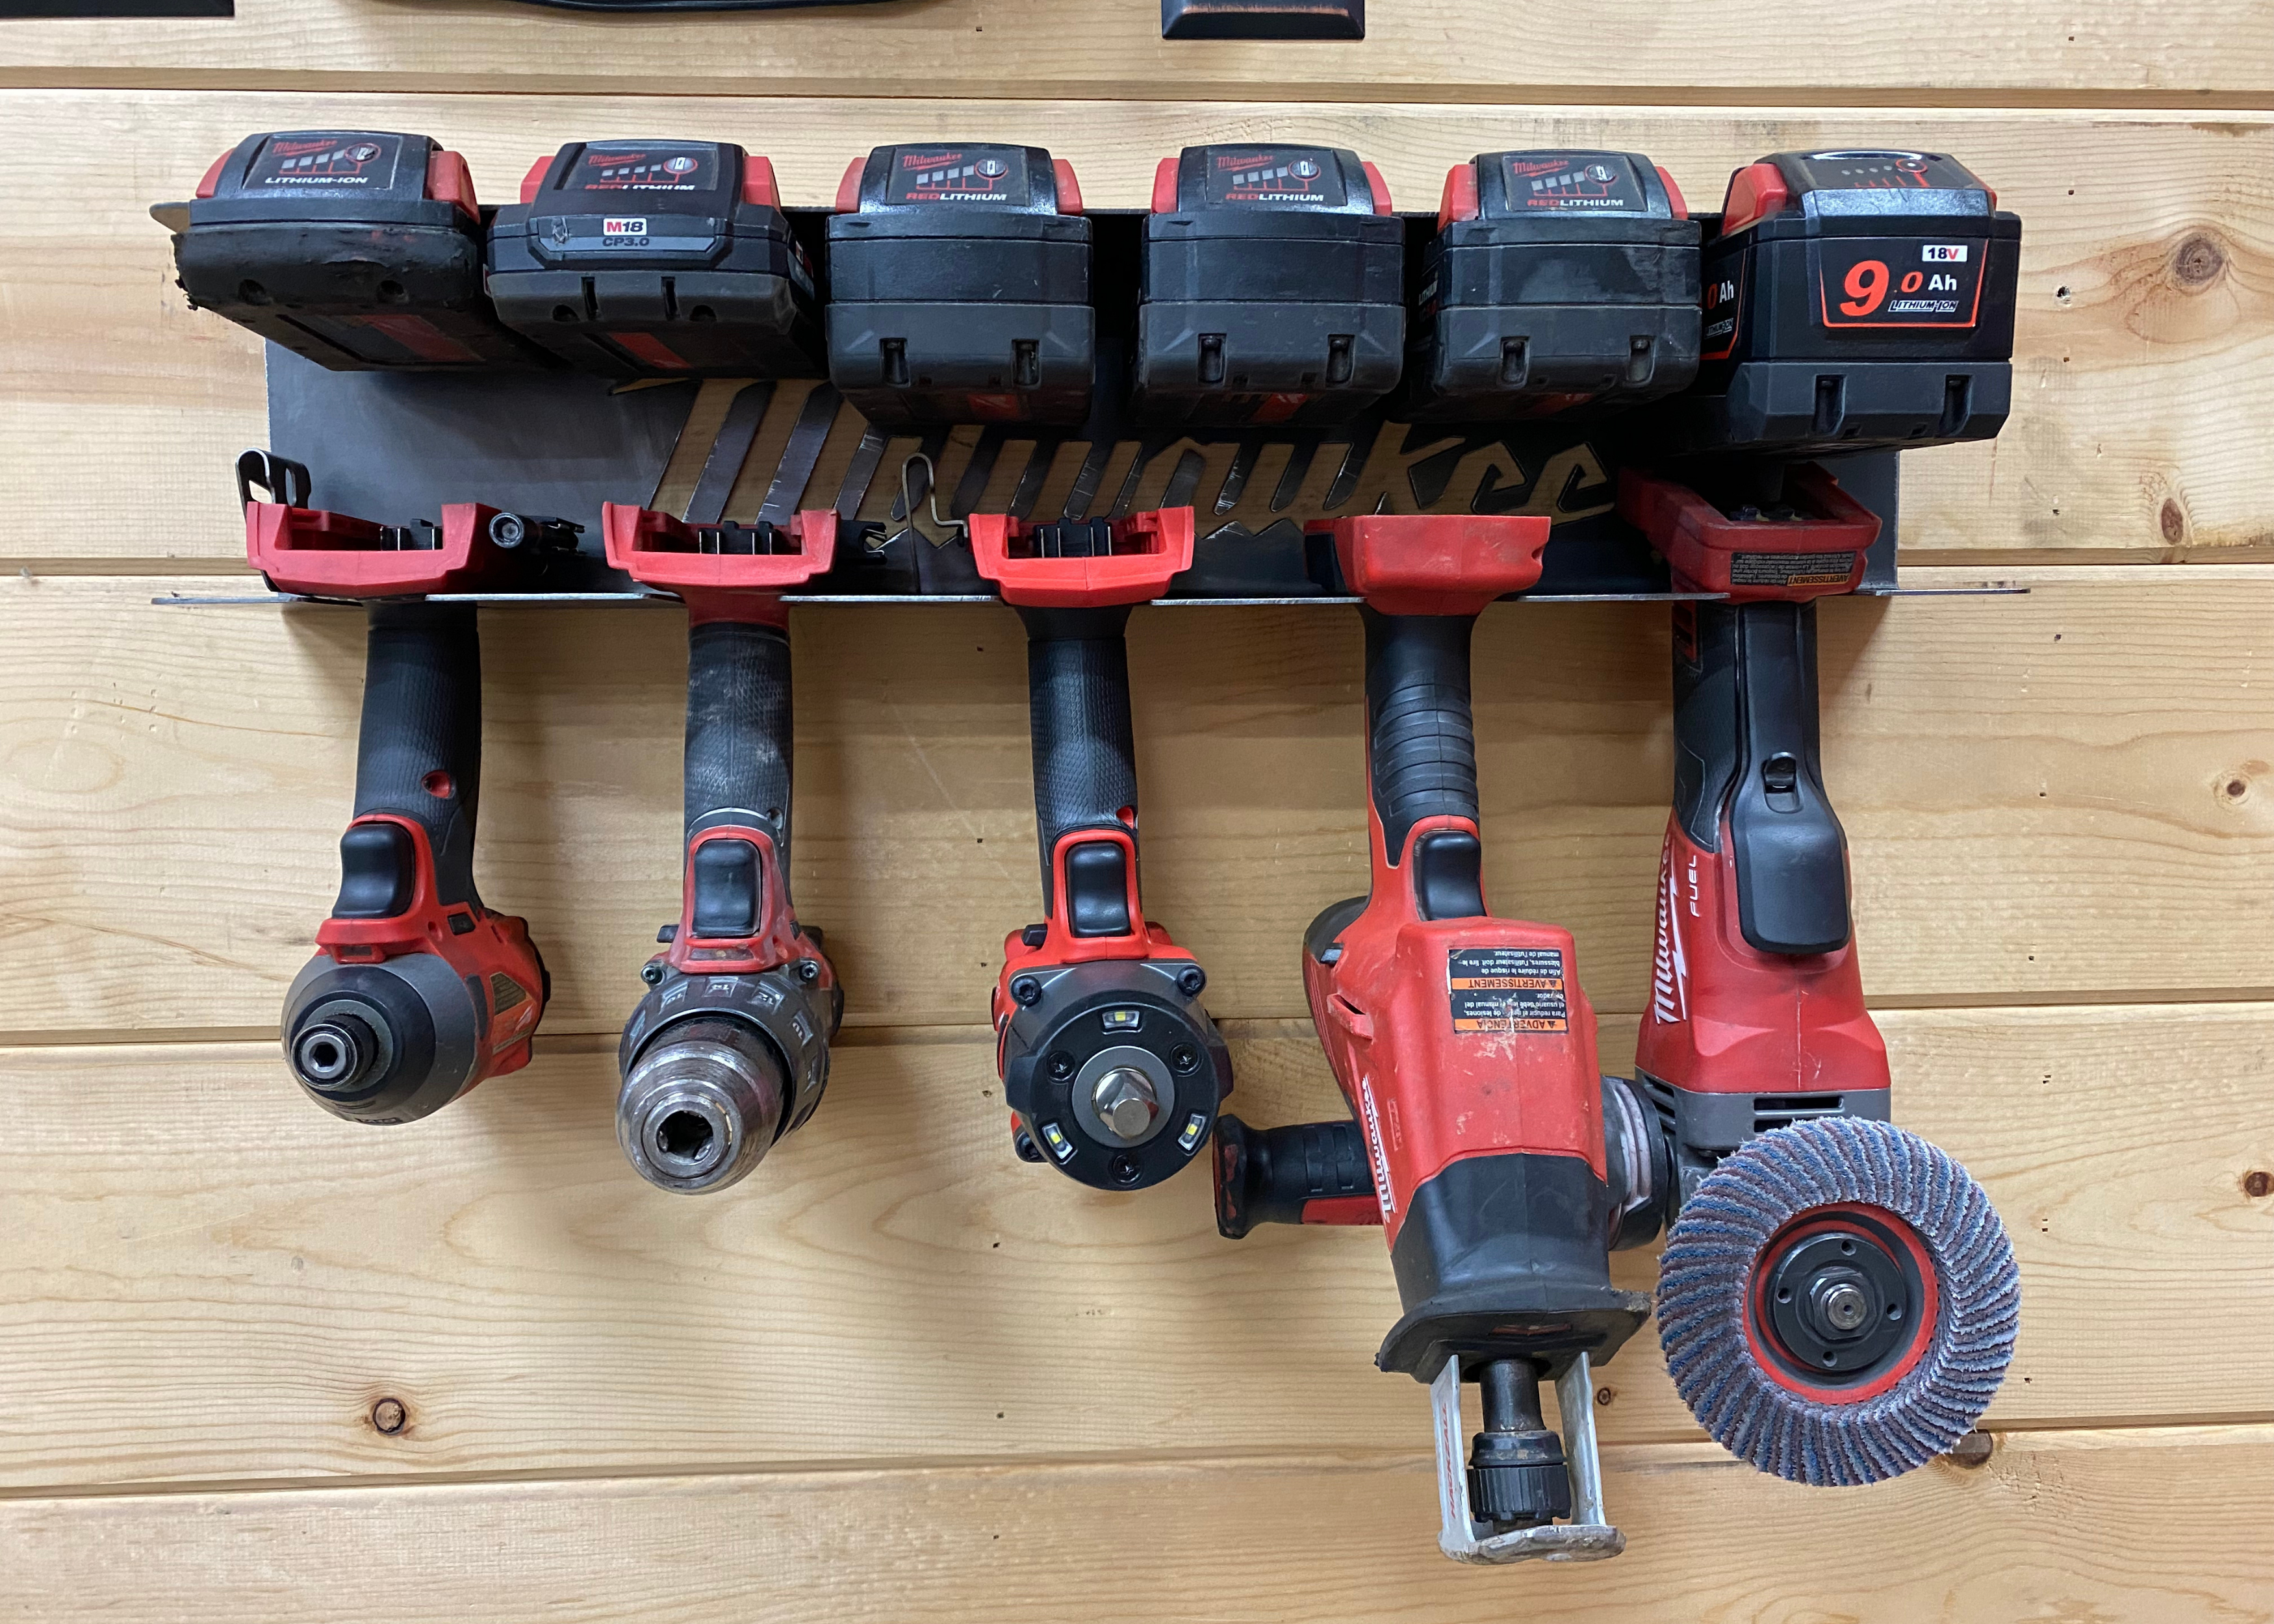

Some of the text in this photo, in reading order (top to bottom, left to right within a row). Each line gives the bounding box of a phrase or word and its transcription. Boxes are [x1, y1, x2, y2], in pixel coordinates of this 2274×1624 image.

[902, 153, 963, 168] Milwaukee
[1513, 159, 1570, 174] Milwaukee
[906, 192, 1007, 201] REDLITHIUM
[606, 221, 644, 233] M18
[602, 236, 650, 247] CP3.0
[1928, 247, 1960, 260] 18V
[1928, 273, 1957, 291] Ah
[1719, 280, 1734, 303] Ah
[1888, 300, 1959, 312] LITHIUM-ION
[1789, 575, 1849, 585] AVERTISSEMENT
[1689, 855, 1700, 917] FUEL
[1468, 978, 1546, 989] AVERTISSEMENT
[1442, 1402, 1456, 1519] HACKZALL
